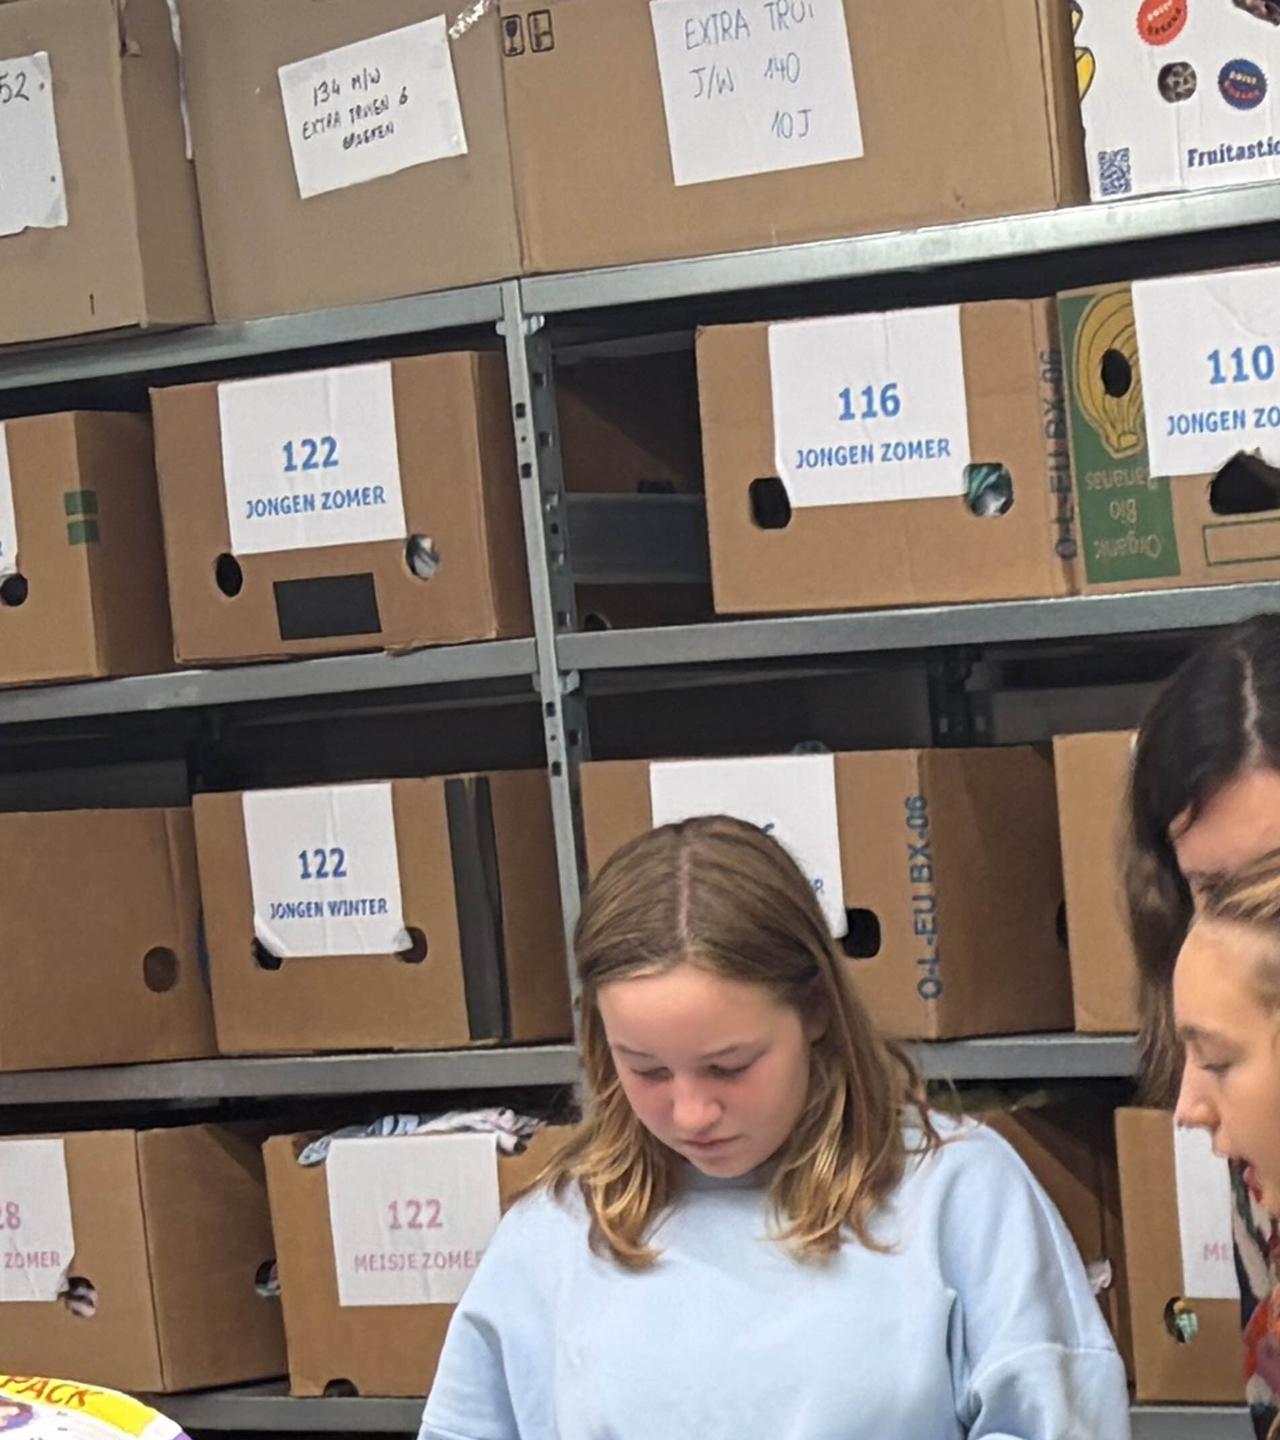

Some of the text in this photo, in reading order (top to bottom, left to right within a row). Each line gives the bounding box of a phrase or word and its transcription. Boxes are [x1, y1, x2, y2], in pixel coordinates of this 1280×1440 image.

[684, 9, 751, 50] EXTRA
[689, 52, 800, 99] J/W 140
[313, 79, 341, 107] 134
[302, 111, 342, 141] EXTRA
[1207, 344, 1276, 385] 110
[837, 383, 902, 422] 116
[1167, 410, 1246, 437] JONGEN
[281, 436, 340, 473] 122
[795, 438, 951, 470] JONGEN ZOMER
[245, 485, 386, 519] JONGEN ZOMER
[1109, 498, 1137, 523] Bio
[1093, 530, 1162, 559] Organic
[298, 848, 347, 880] 122
[270, 897, 388, 921] JONGEN WINTER
[387, 1199, 443, 1230] 122
[4, 1250, 61, 1270] ZOMER
[354, 1252, 417, 1273] MEISJE
